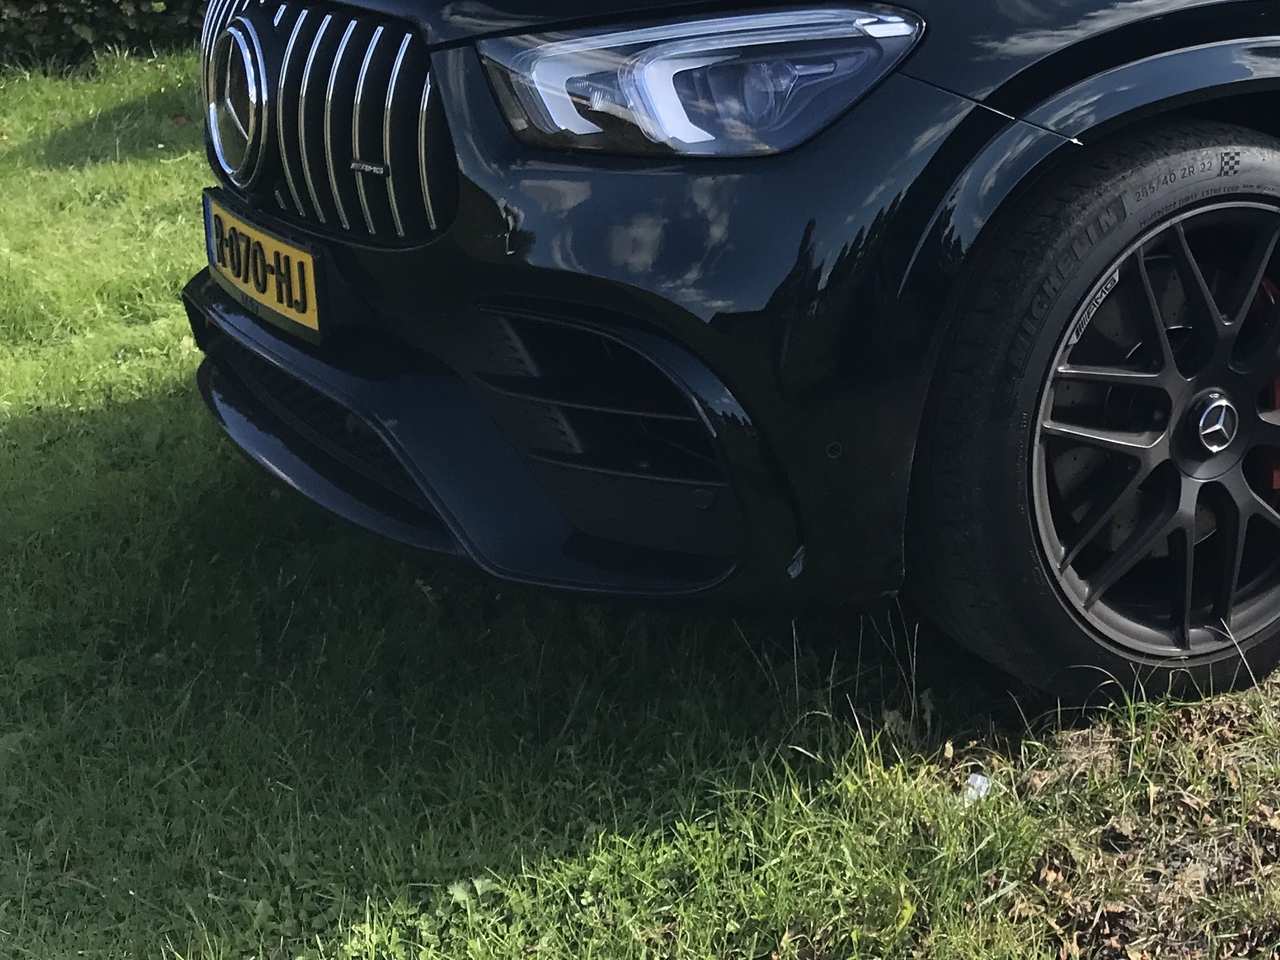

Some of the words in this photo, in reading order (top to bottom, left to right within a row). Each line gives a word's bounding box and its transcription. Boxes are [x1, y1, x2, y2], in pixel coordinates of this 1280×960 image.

[1134, 171, 1177, 203] 285/40
[1180, 165, 1195, 180] ZR
[1200, 161, 1213, 173] 22
[213, 214, 308, 314] R-070-HJ
[1008, 206, 1119, 369] MICHELIN
[1085, 277, 1117, 321] AMG
